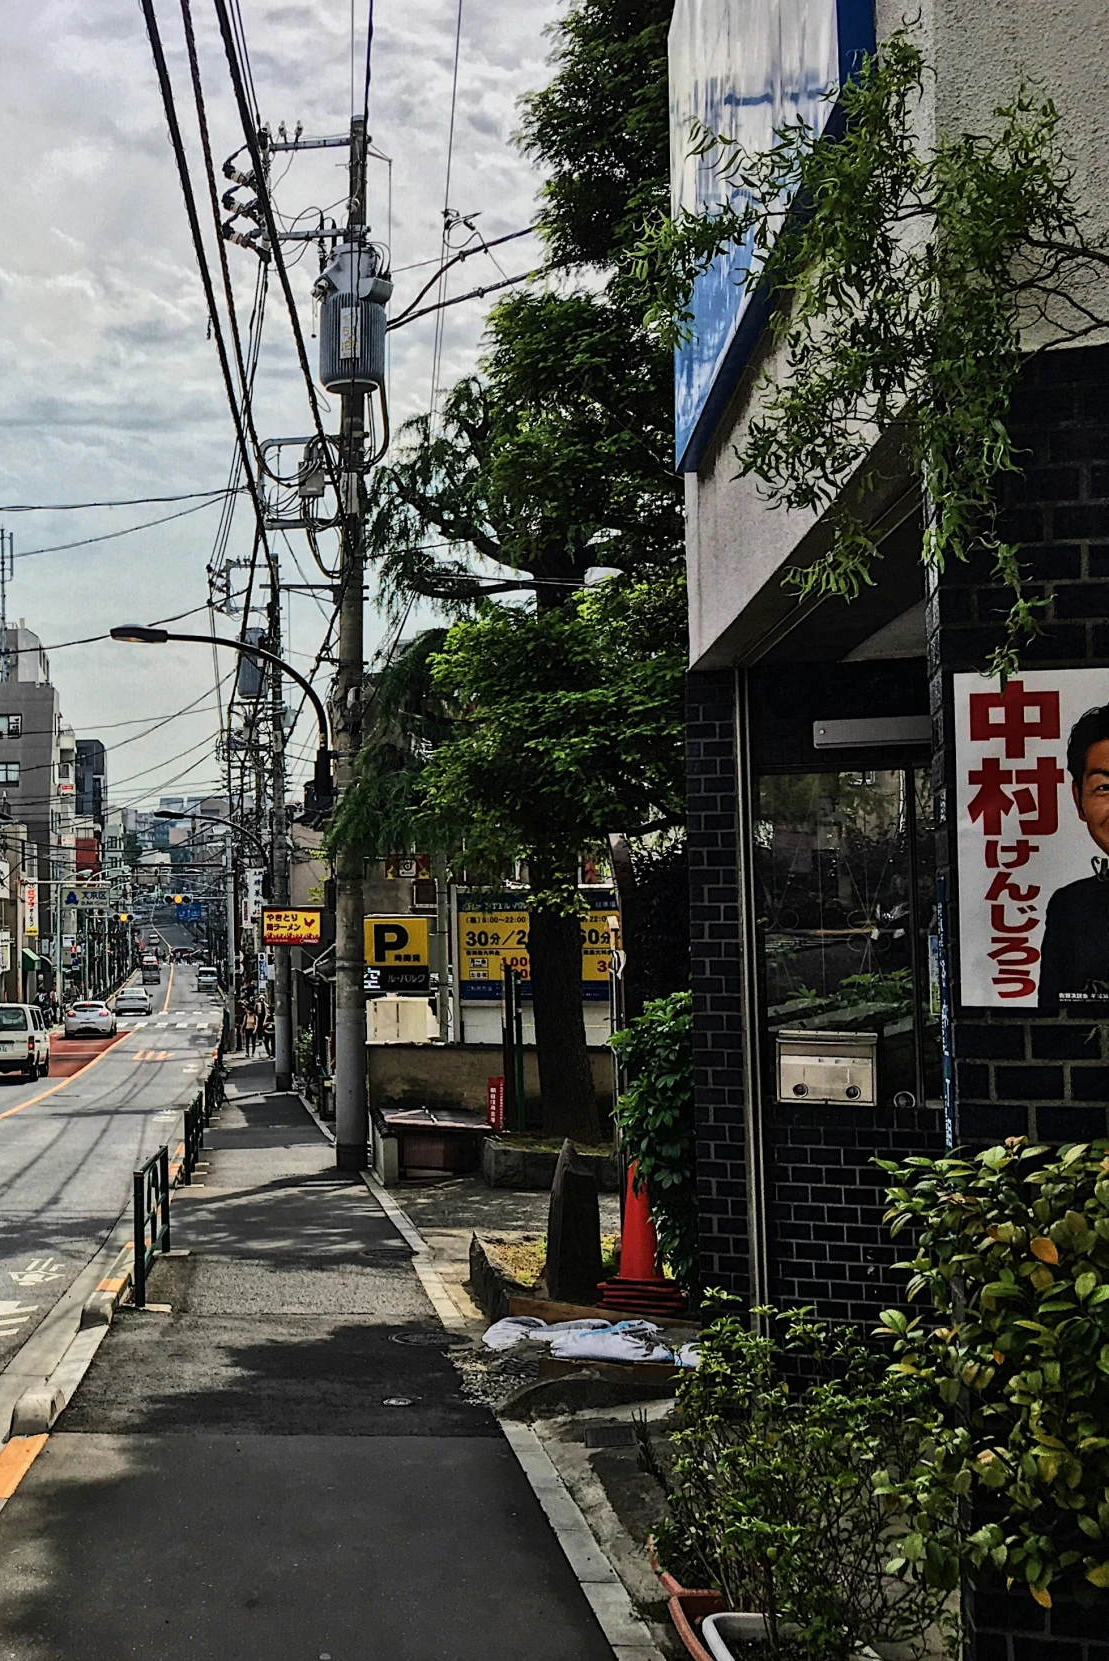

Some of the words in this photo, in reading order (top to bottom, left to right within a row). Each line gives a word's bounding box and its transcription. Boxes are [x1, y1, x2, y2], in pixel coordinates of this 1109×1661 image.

[967, 680, 1065, 999] 中村けんじろう
[81, 891, 107, 899] 文京区
[266, 914, 298, 922] やきとり
[374, 924, 409, 962] P
[394, 953, 421, 962] 時間貸
